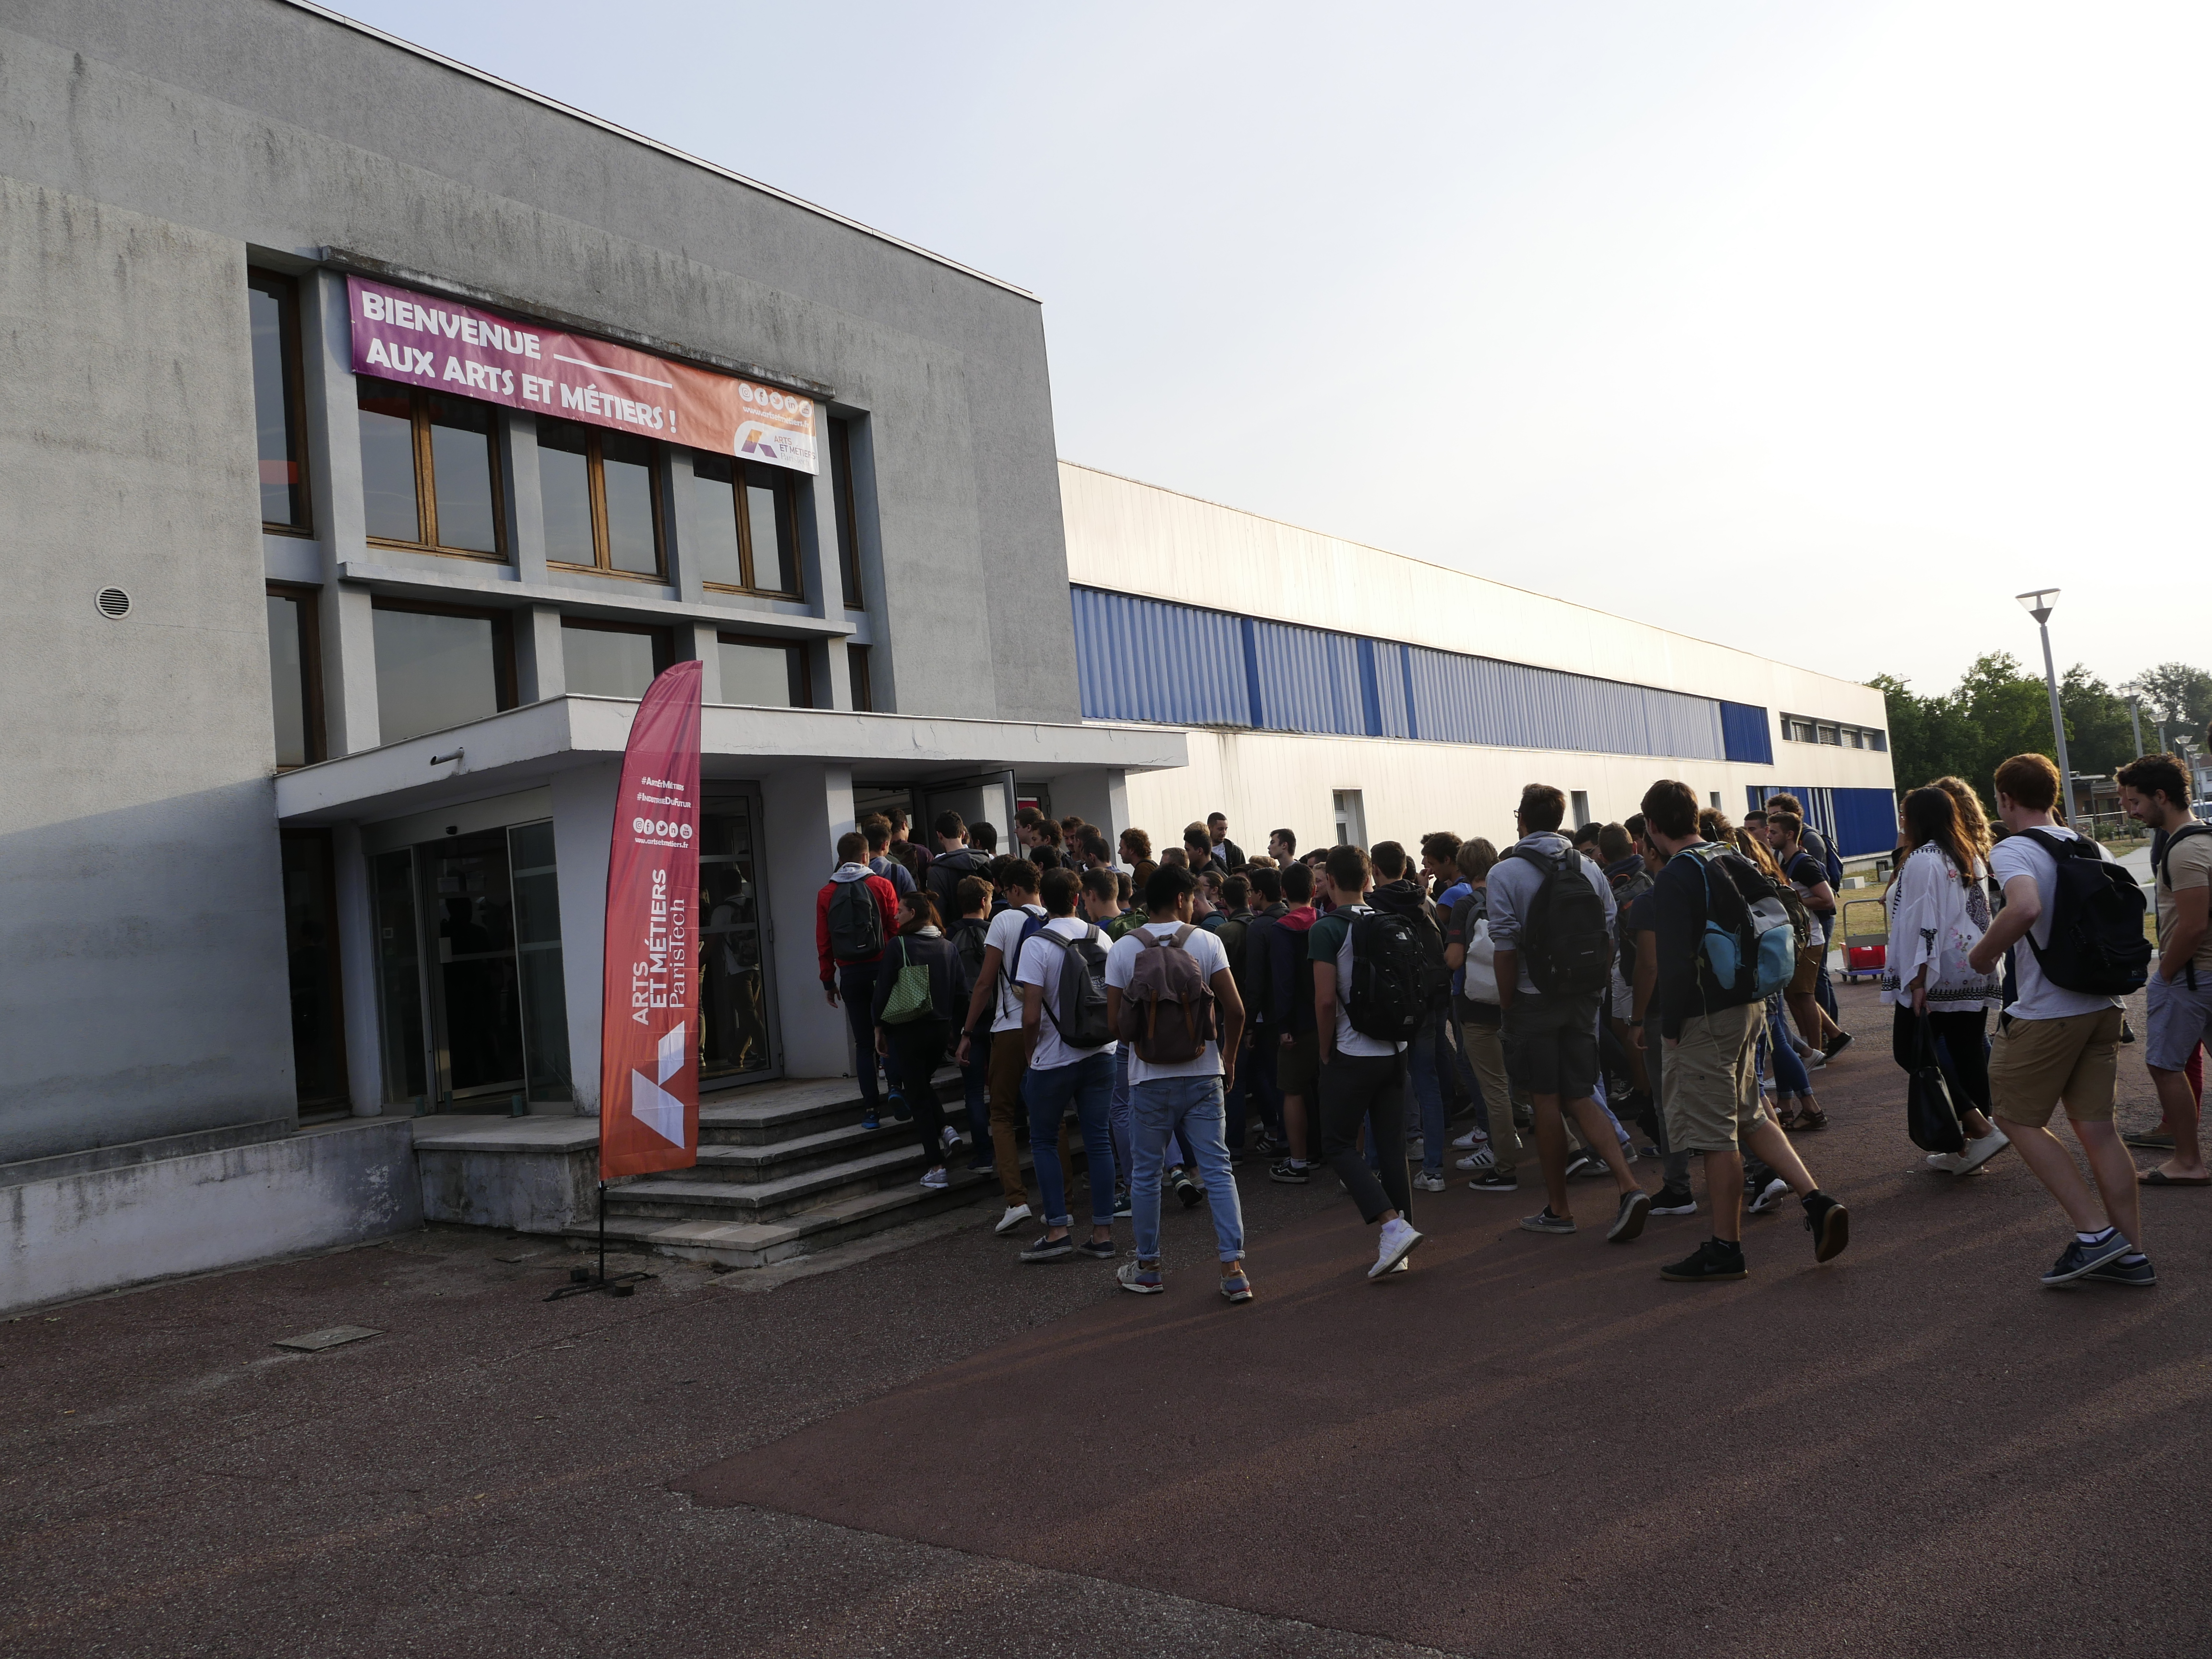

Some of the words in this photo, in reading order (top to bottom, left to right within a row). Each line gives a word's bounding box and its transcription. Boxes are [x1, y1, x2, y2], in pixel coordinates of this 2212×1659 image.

[361, 290, 541, 360] BIENVENUE
[366, 338, 435, 378] AUX
[443, 356, 514, 396] ARTS
[521, 373, 553, 404] ET
[560, 383, 663, 430] MÉTIERS
[669, 409, 676, 433] !
[743, 406, 810, 428] www.artsetmetiers.fr
[774, 435, 792, 445] ARTS
[780, 444, 788, 452] ET
[790, 445, 816, 459] MÉTIERS
[781, 452, 810, 467] ParisTech
[644, 869, 667, 973] MÉTIERS
[669, 899, 685, 1008] ParisTech
[632, 962, 649, 1025] ARTS
[650, 978, 667, 1008] ET
